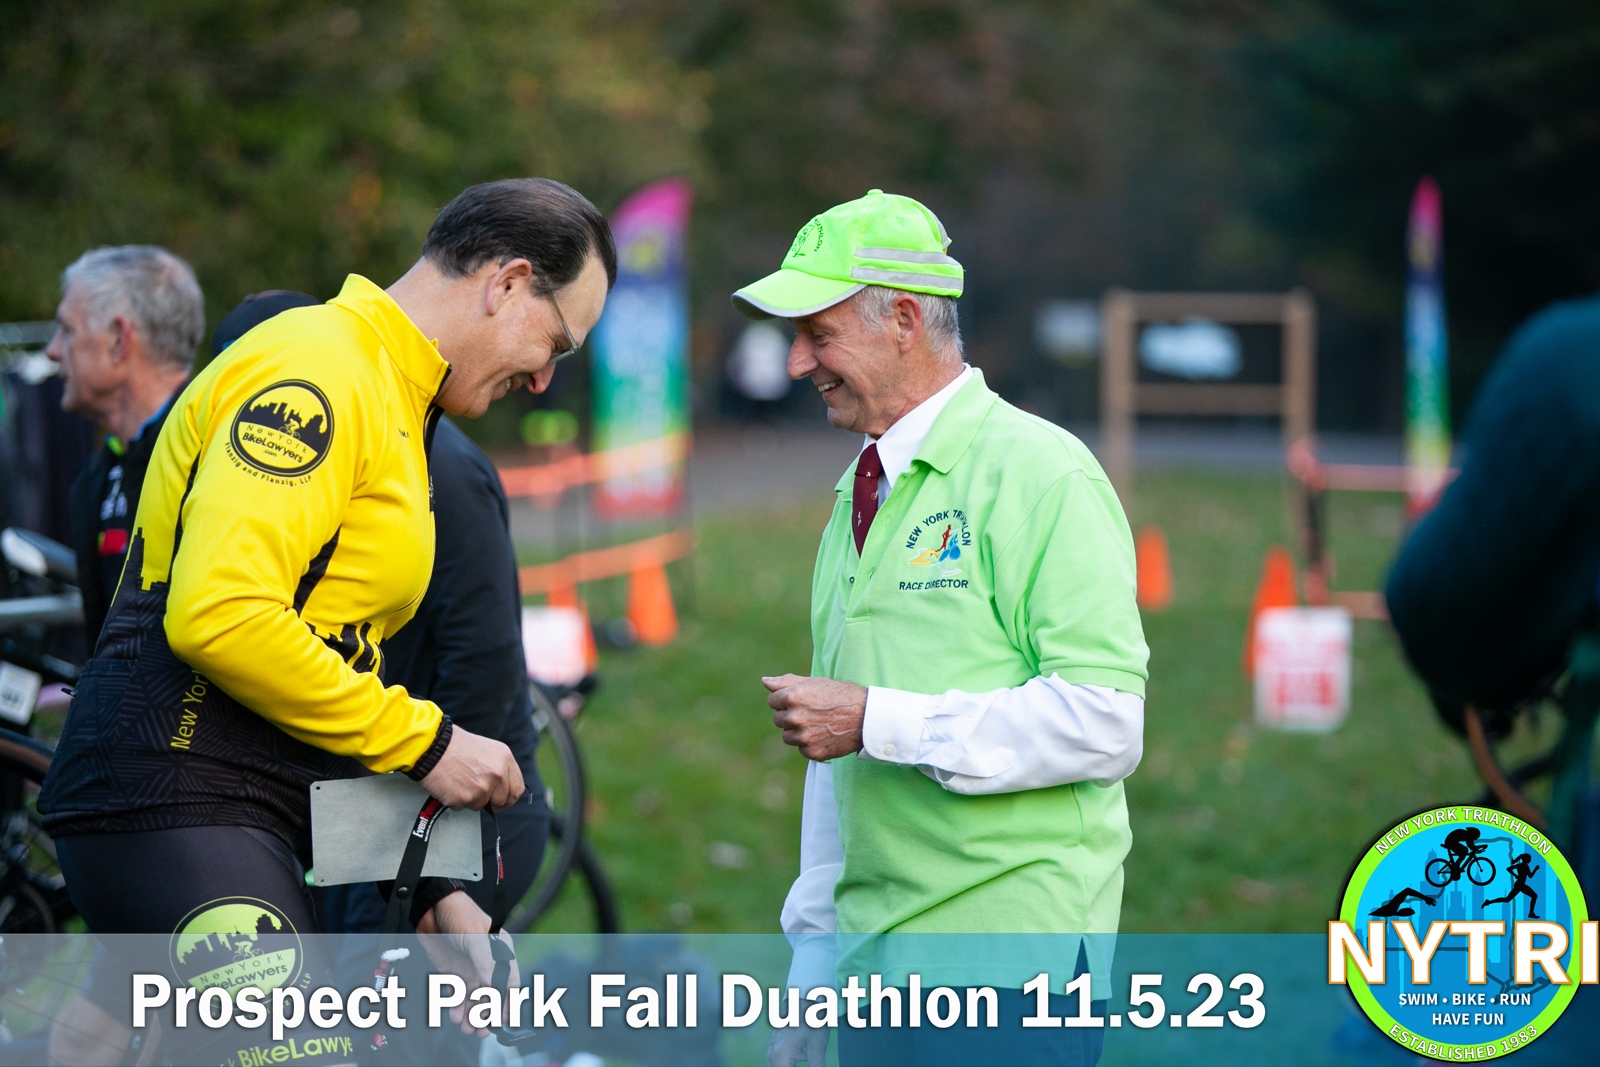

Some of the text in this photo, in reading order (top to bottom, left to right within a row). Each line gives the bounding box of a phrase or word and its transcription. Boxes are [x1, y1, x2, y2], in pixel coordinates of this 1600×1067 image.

[242, 432, 304, 463] BikeLawyers
[242, 466, 258, 477] and
[299, 475, 312, 484] LLP
[905, 526, 923, 549] NEW
[922, 510, 950, 527] YORK
[899, 579, 969, 590] RACE DIRECTOR
[170, 669, 210, 750] New Yor
